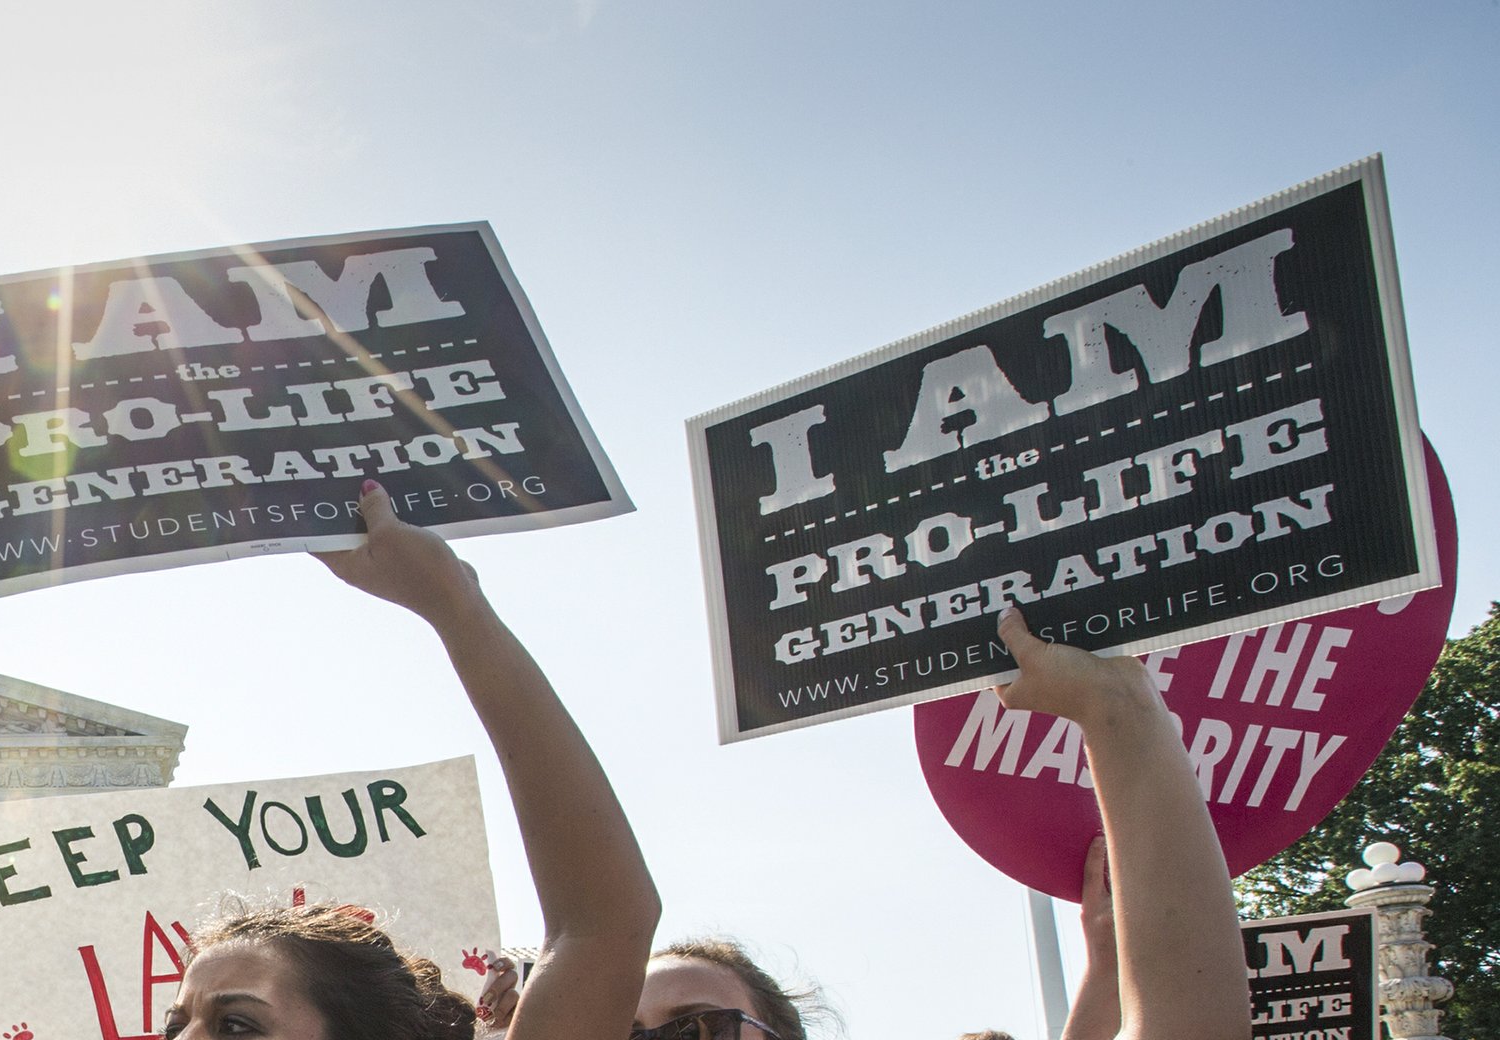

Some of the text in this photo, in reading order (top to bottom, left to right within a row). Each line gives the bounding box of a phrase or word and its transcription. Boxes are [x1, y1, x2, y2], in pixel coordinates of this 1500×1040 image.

[71, 247, 467, 362] AM
[175, 359, 241, 382] the
[749, 228, 1310, 515] I AM
[765, 398, 1328, 611] PRO-LIFE
[975, 447, 1041, 481] the
[773, 482, 1335, 666] GENERATION
[778, 554, 1344, 710] WWW.STUDENSFORLIFE.ORG
[1208, 622, 1353, 711] THE
[943, 689, 1348, 812] MARITY
[203, 779, 426, 870] YOUR
[1248, 924, 1351, 979] M
